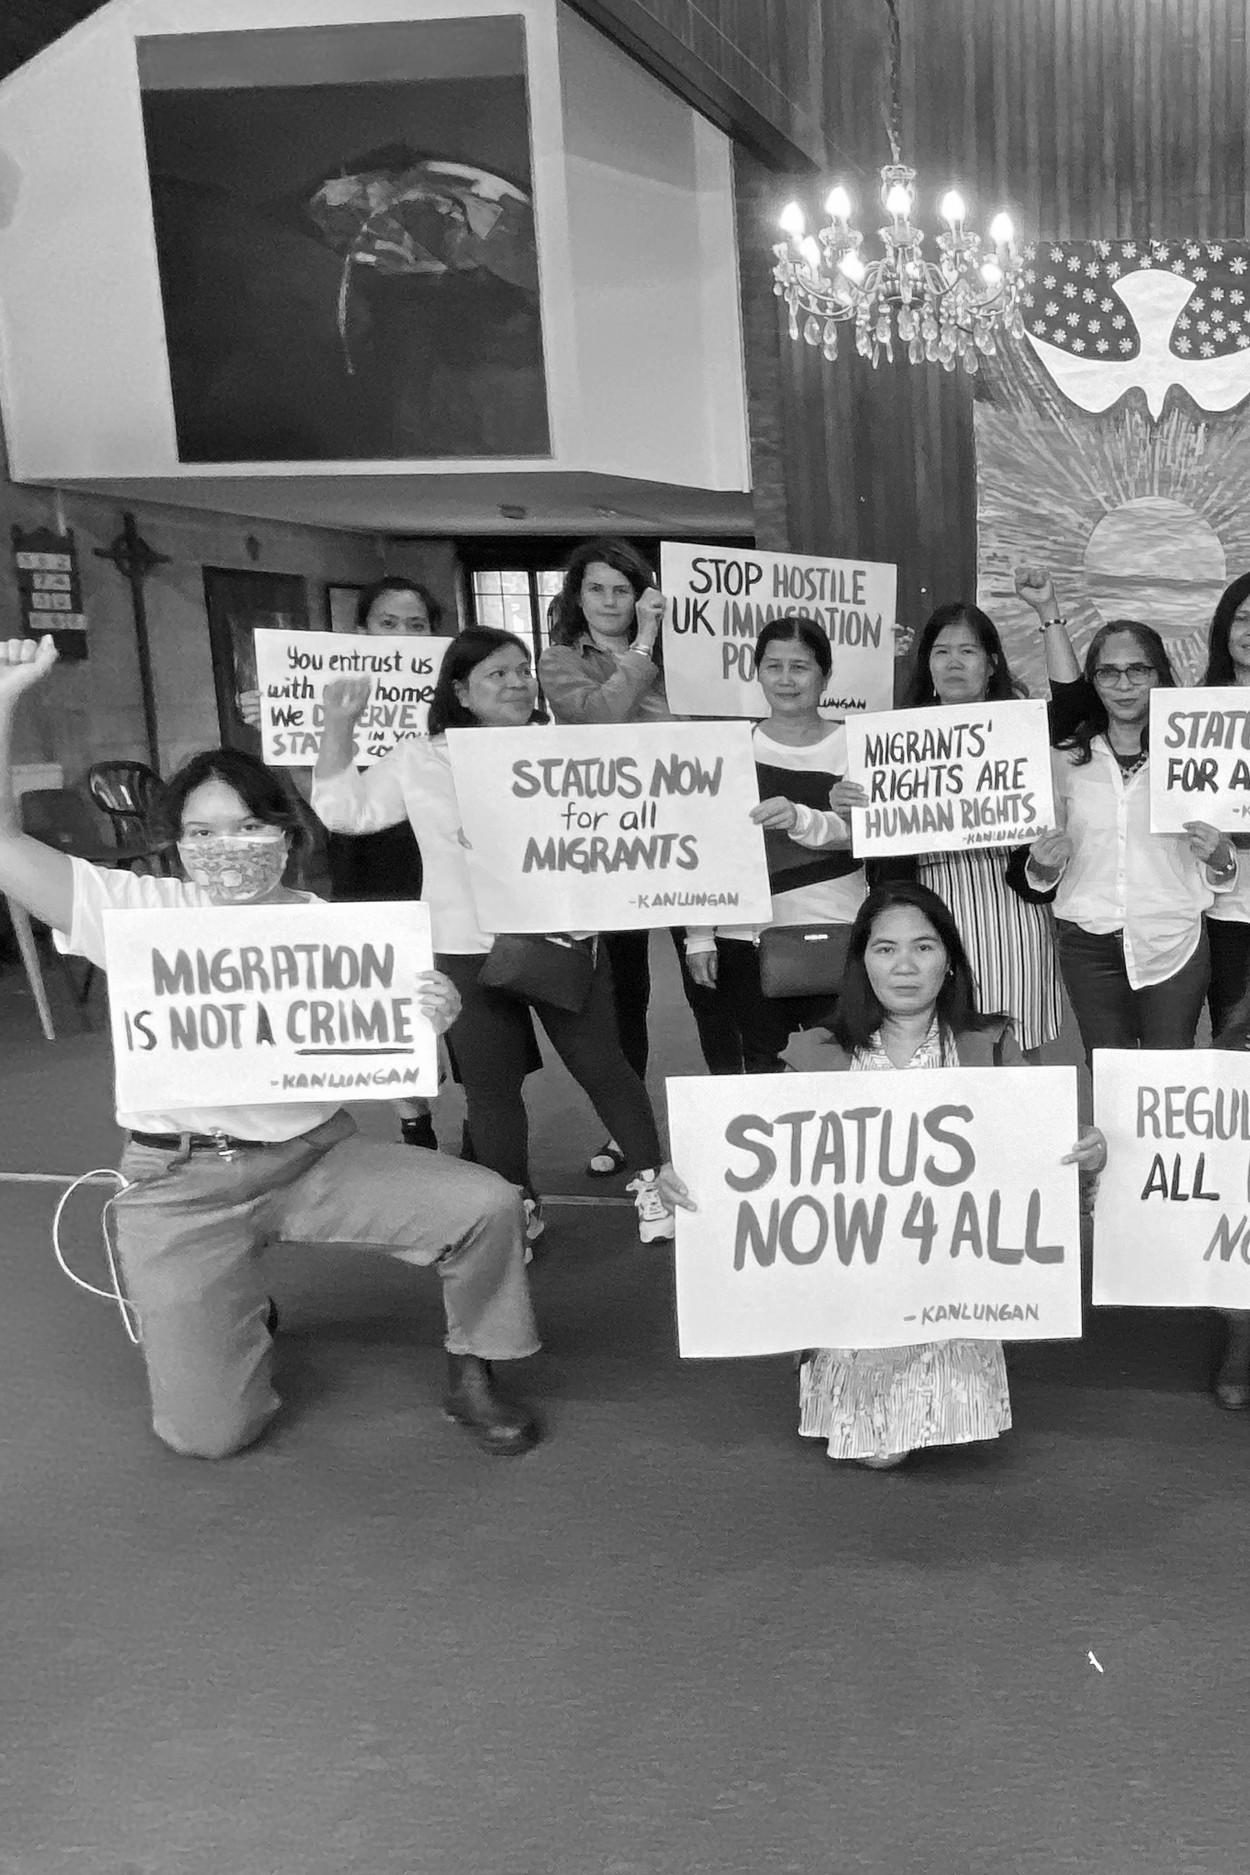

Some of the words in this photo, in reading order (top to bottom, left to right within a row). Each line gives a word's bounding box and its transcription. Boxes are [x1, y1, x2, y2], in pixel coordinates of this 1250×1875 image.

[689, 557, 763, 595] STOP
[773, 563, 866, 605] HOSTILE
[672, 596, 716, 636] UK
[329, 649, 403, 672] entrust
[411, 657, 434, 674] us
[268, 676, 315, 699] with
[271, 704, 304, 727] We
[313, 704, 418, 729] DERVE
[865, 719, 992, 768] MIGRANTS'
[512, 757, 642, 798] STATUS
[650, 753, 723, 797] NOW
[871, 764, 963, 803] RIGHTS
[976, 757, 1028, 792] ARE
[1167, 757, 1219, 794] FOR
[561, 802, 608, 830] for
[619, 801, 657, 830] all
[865, 799, 954, 839] HUMAN
[960, 792, 1037, 830] RIGHTS
[522, 834, 698, 874] MIGRANTS
[152, 943, 394, 996] MIGRATION
[125, 1010, 157, 1051] IS
[169, 1004, 246, 1050] NOT
[256, 1001, 277, 1047] A
[287, 998, 414, 1045] CRIME
[724, 1104, 976, 1192] STATUS
[1141, 1152, 1220, 1201] ALL
[733, 1192, 888, 1271] NOW
[902, 1190, 938, 1265] 4
[950, 1188, 1064, 1265] ALL
